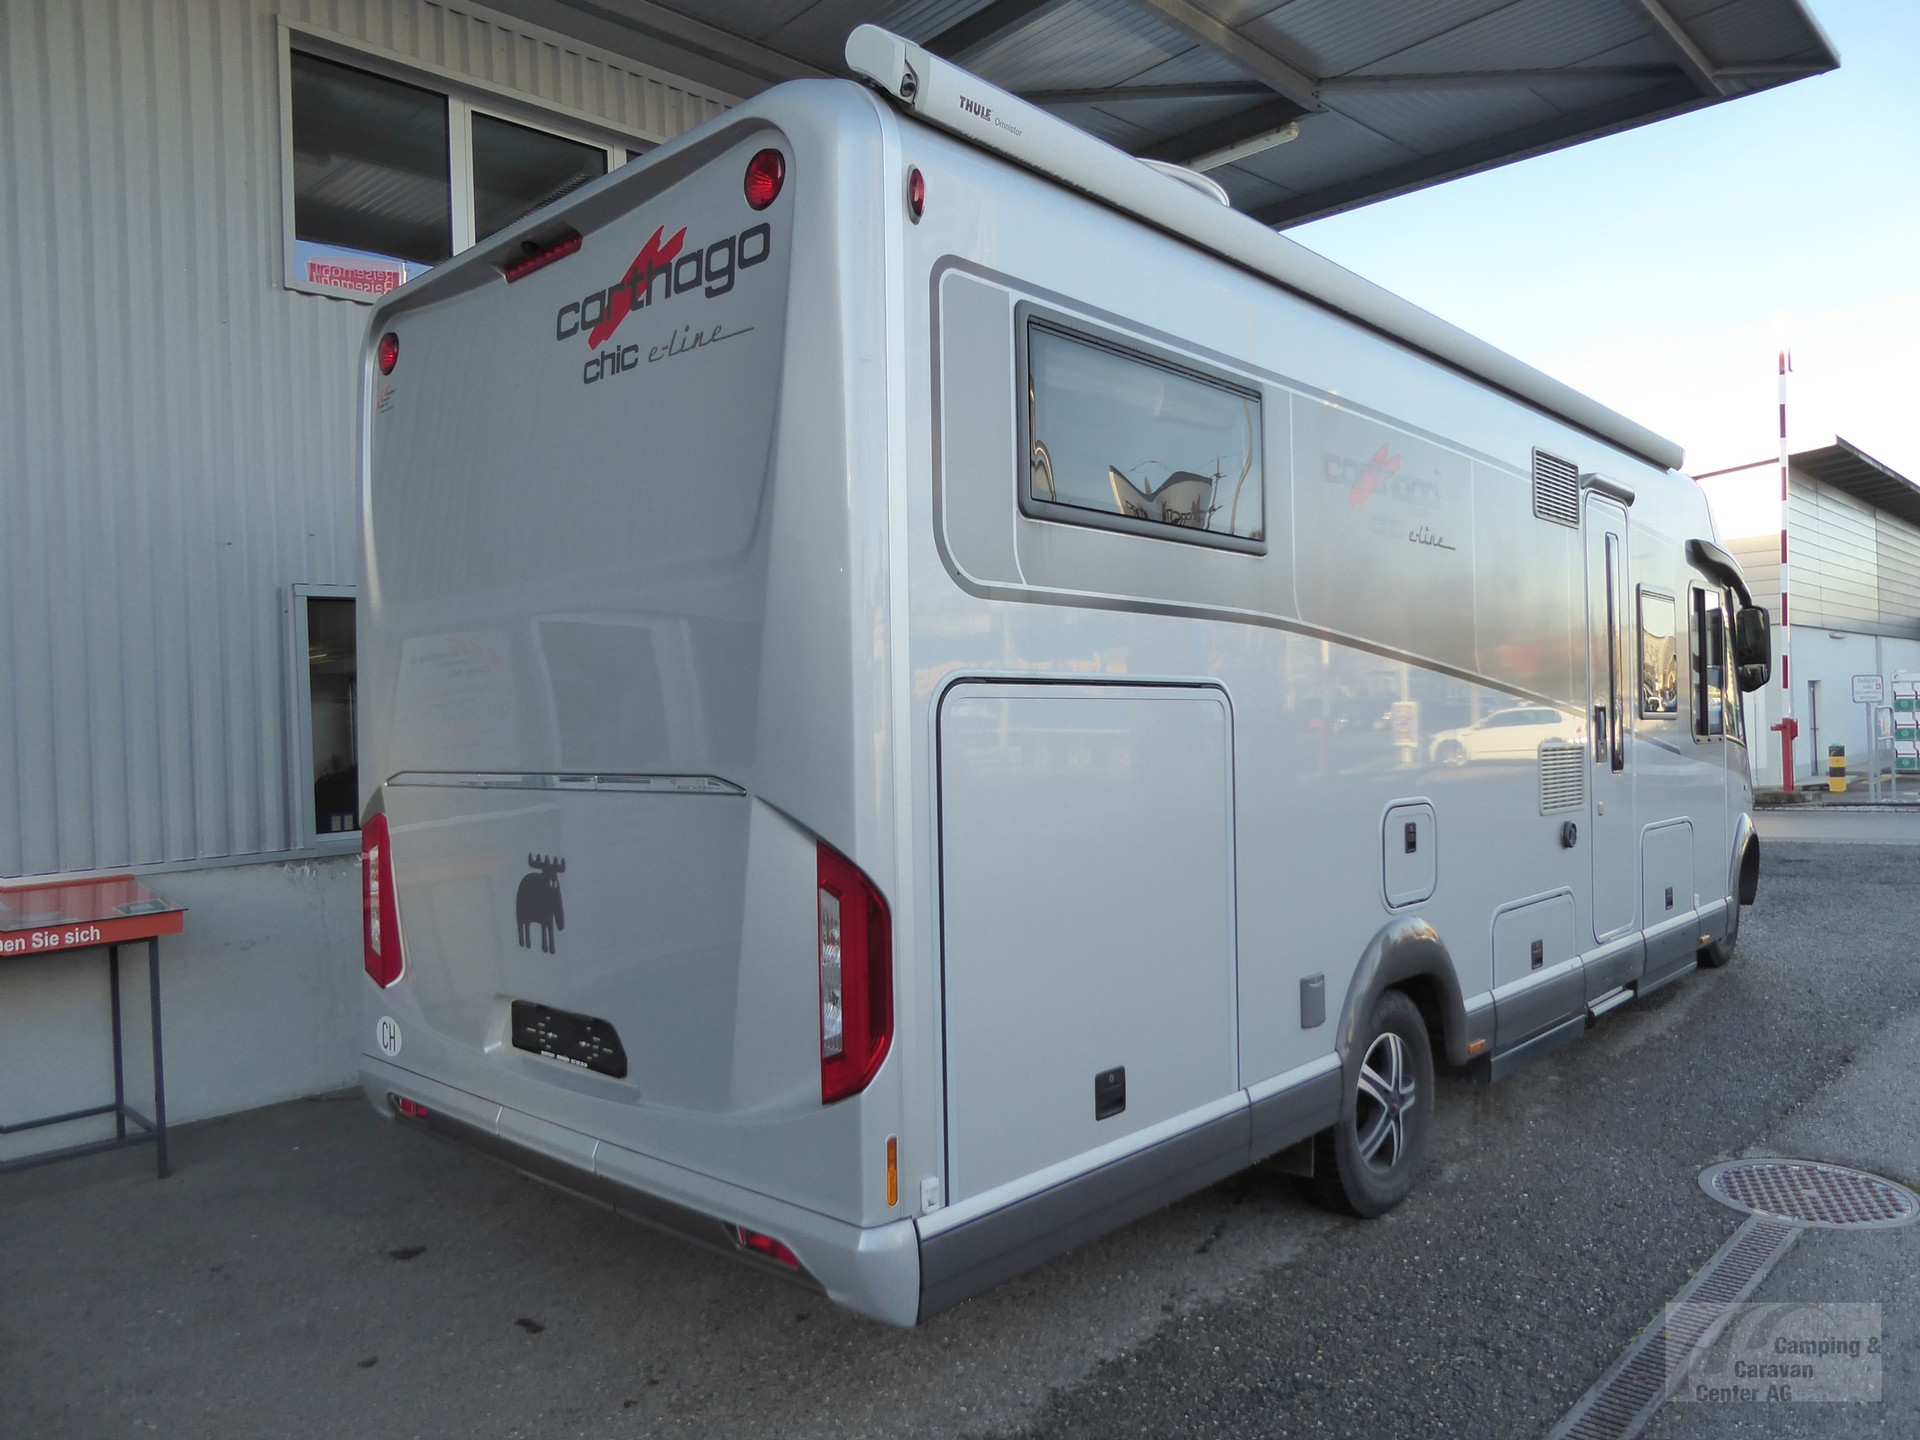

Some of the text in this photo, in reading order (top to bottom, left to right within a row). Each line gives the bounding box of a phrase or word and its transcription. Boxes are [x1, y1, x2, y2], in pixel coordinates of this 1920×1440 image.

[960, 95, 1023, 137] THULE Omnistor
[556, 222, 771, 342] carthago
[583, 324, 755, 385] chic e-line
[31, 931, 60, 949] Sie
[64, 925, 101, 944] sich
[382, 1021, 396, 1053] CH
